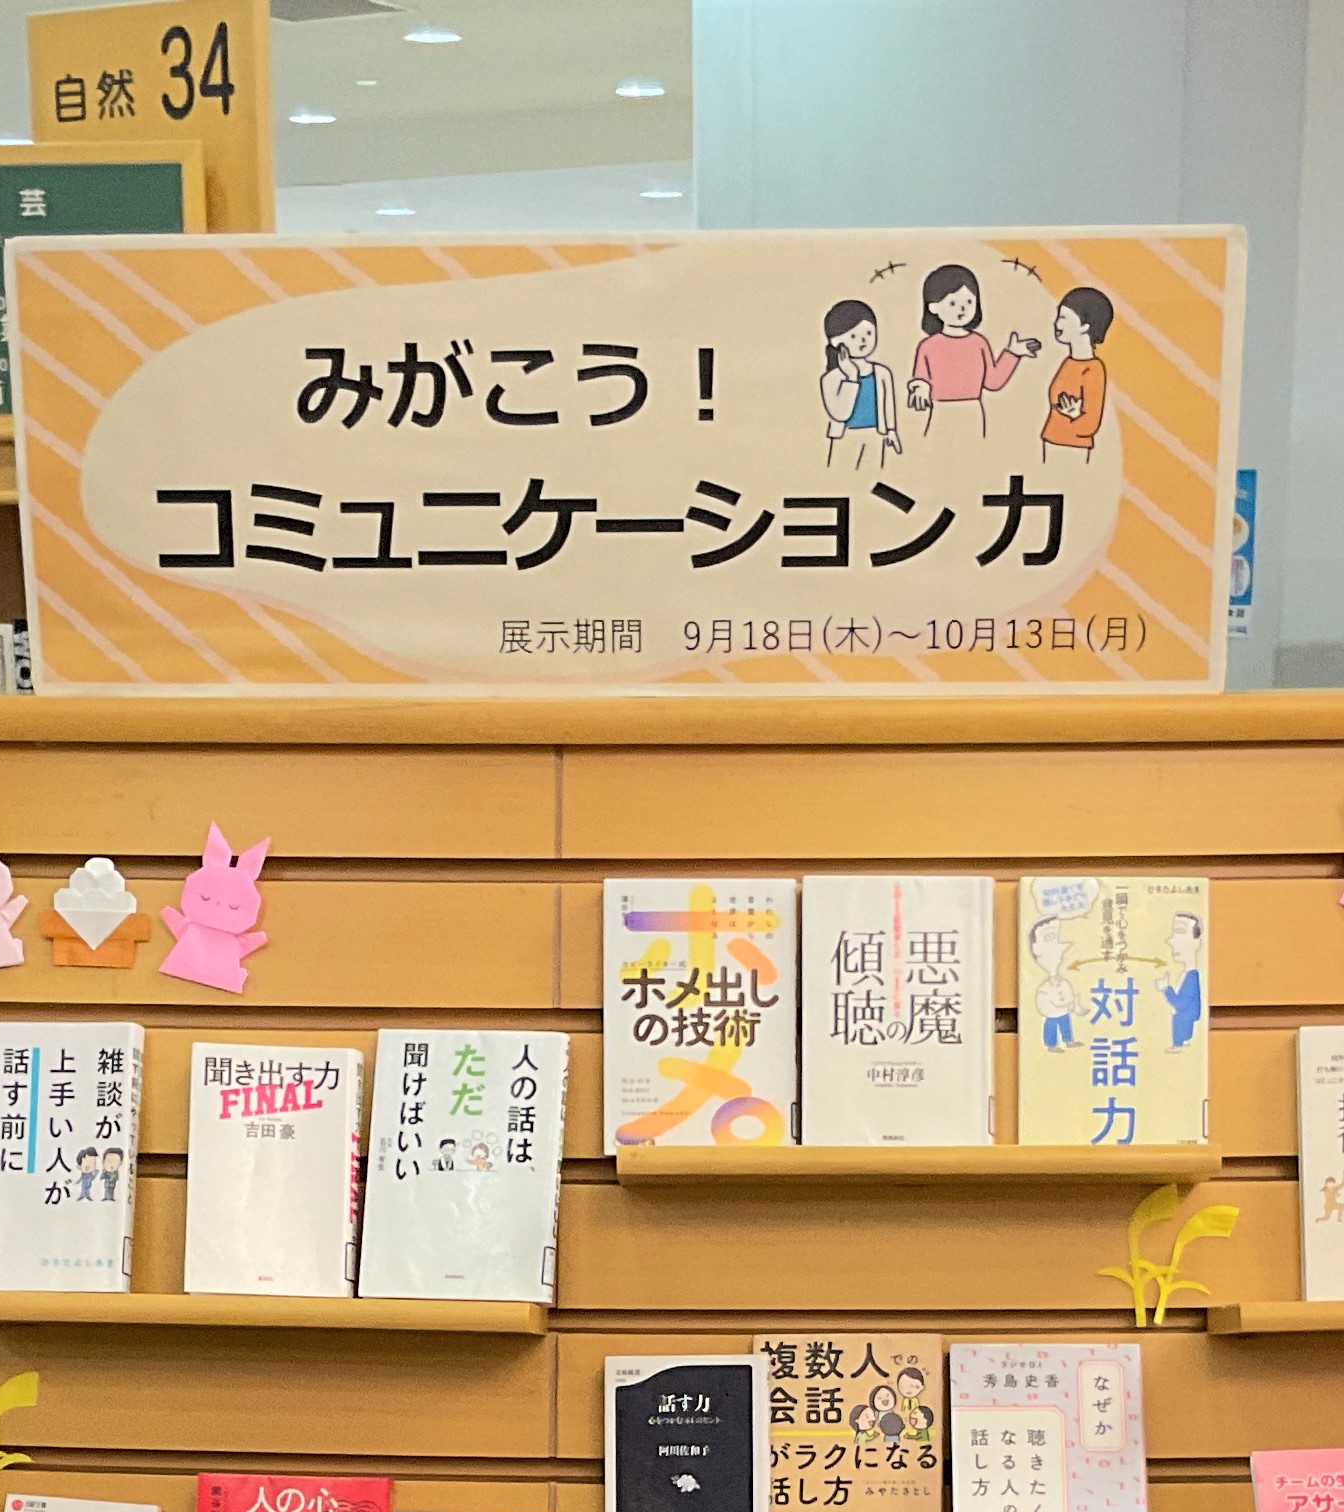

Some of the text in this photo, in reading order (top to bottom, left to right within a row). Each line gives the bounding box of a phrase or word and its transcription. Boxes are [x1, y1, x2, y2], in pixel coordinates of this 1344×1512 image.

[55, 21, 236, 123] 自然 34
[297, 338, 715, 430] みがこう！
[155, 474, 1067, 574] コミュニケーション力
[498, 617, 644, 657] 展示期間
[620, 964, 781, 1010] ホメ出し
[829, 929, 887, 1046] 傾聴
[632, 1007, 762, 1048] の技術
[1090, 976, 1140, 1145] 対話力
[95, 1047, 125, 1140] 雑談が
[203, 1056, 342, 1092] 聞き出す力
[218, 1079, 324, 1121] FINAL
[448, 1043, 487, 1118] ただ
[506, 1043, 540, 1173] 人の話は、
[866, 1066, 926, 1083] 中村淳彦
[0, 1047, 30, 1172] 話す前に
[44, 1047, 77, 1206] 上手い人が
[394, 1042, 430, 1181] 聞けばいい
[657, 1393, 711, 1414] 話す力
[769, 1385, 845, 1425] 会話
[982, 1373, 1061, 1389] 秀島史香
[1092, 1374, 1114, 1437] なぜか
[769, 1442, 939, 1471] がラクになる
[969, 1428, 991, 1497] 話し方
